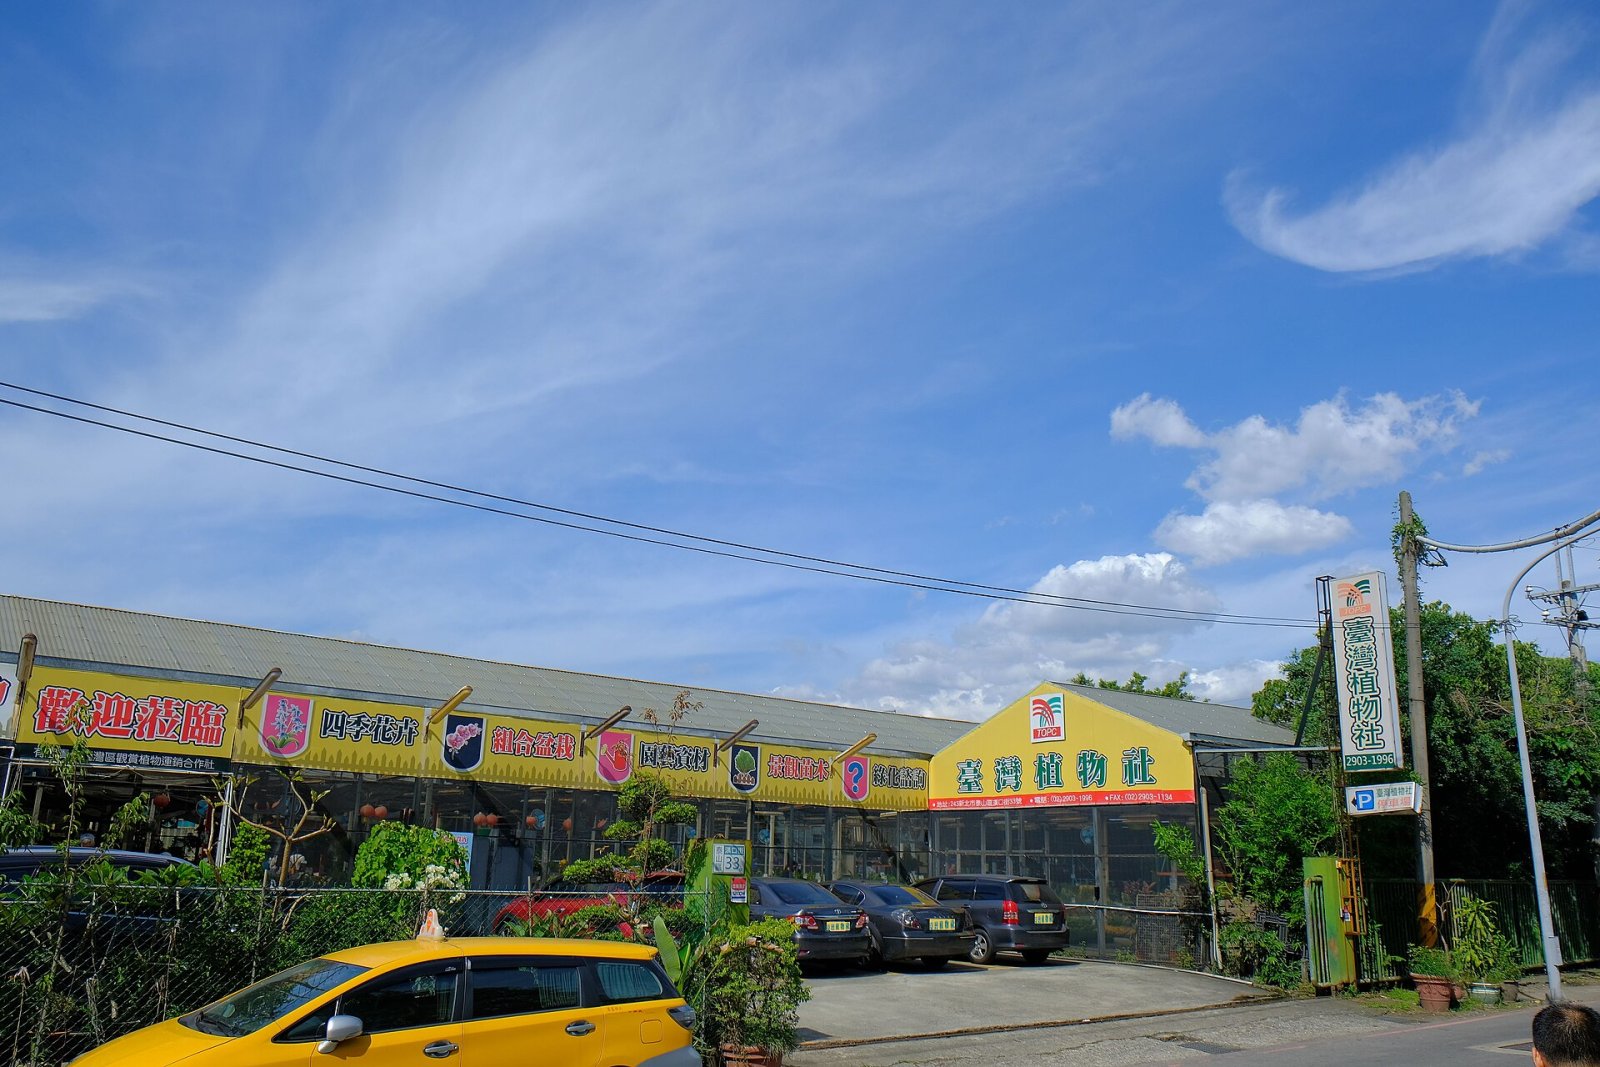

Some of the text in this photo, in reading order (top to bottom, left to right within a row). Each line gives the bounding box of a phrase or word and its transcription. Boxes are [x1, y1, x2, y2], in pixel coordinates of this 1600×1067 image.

[1342, 616, 1385, 751] 臺灣植物社
[32, 686, 228, 746] 歡迎蒞臨
[319, 708, 419, 747] 四季花卉
[491, 725, 576, 761] 組合盆栽
[1036, 727, 1057, 738] TOPC
[639, 741, 711, 773] 園藝資材
[767, 753, 830, 782] 景觀苗木
[957, 746, 1157, 794] 臺灣植物社
[1346, 755, 1394, 767] 2903-1996
[872, 764, 927, 790] 綠化諮詢
[1358, 793, 1372, 809] P
[725, 856, 740, 870] 33
